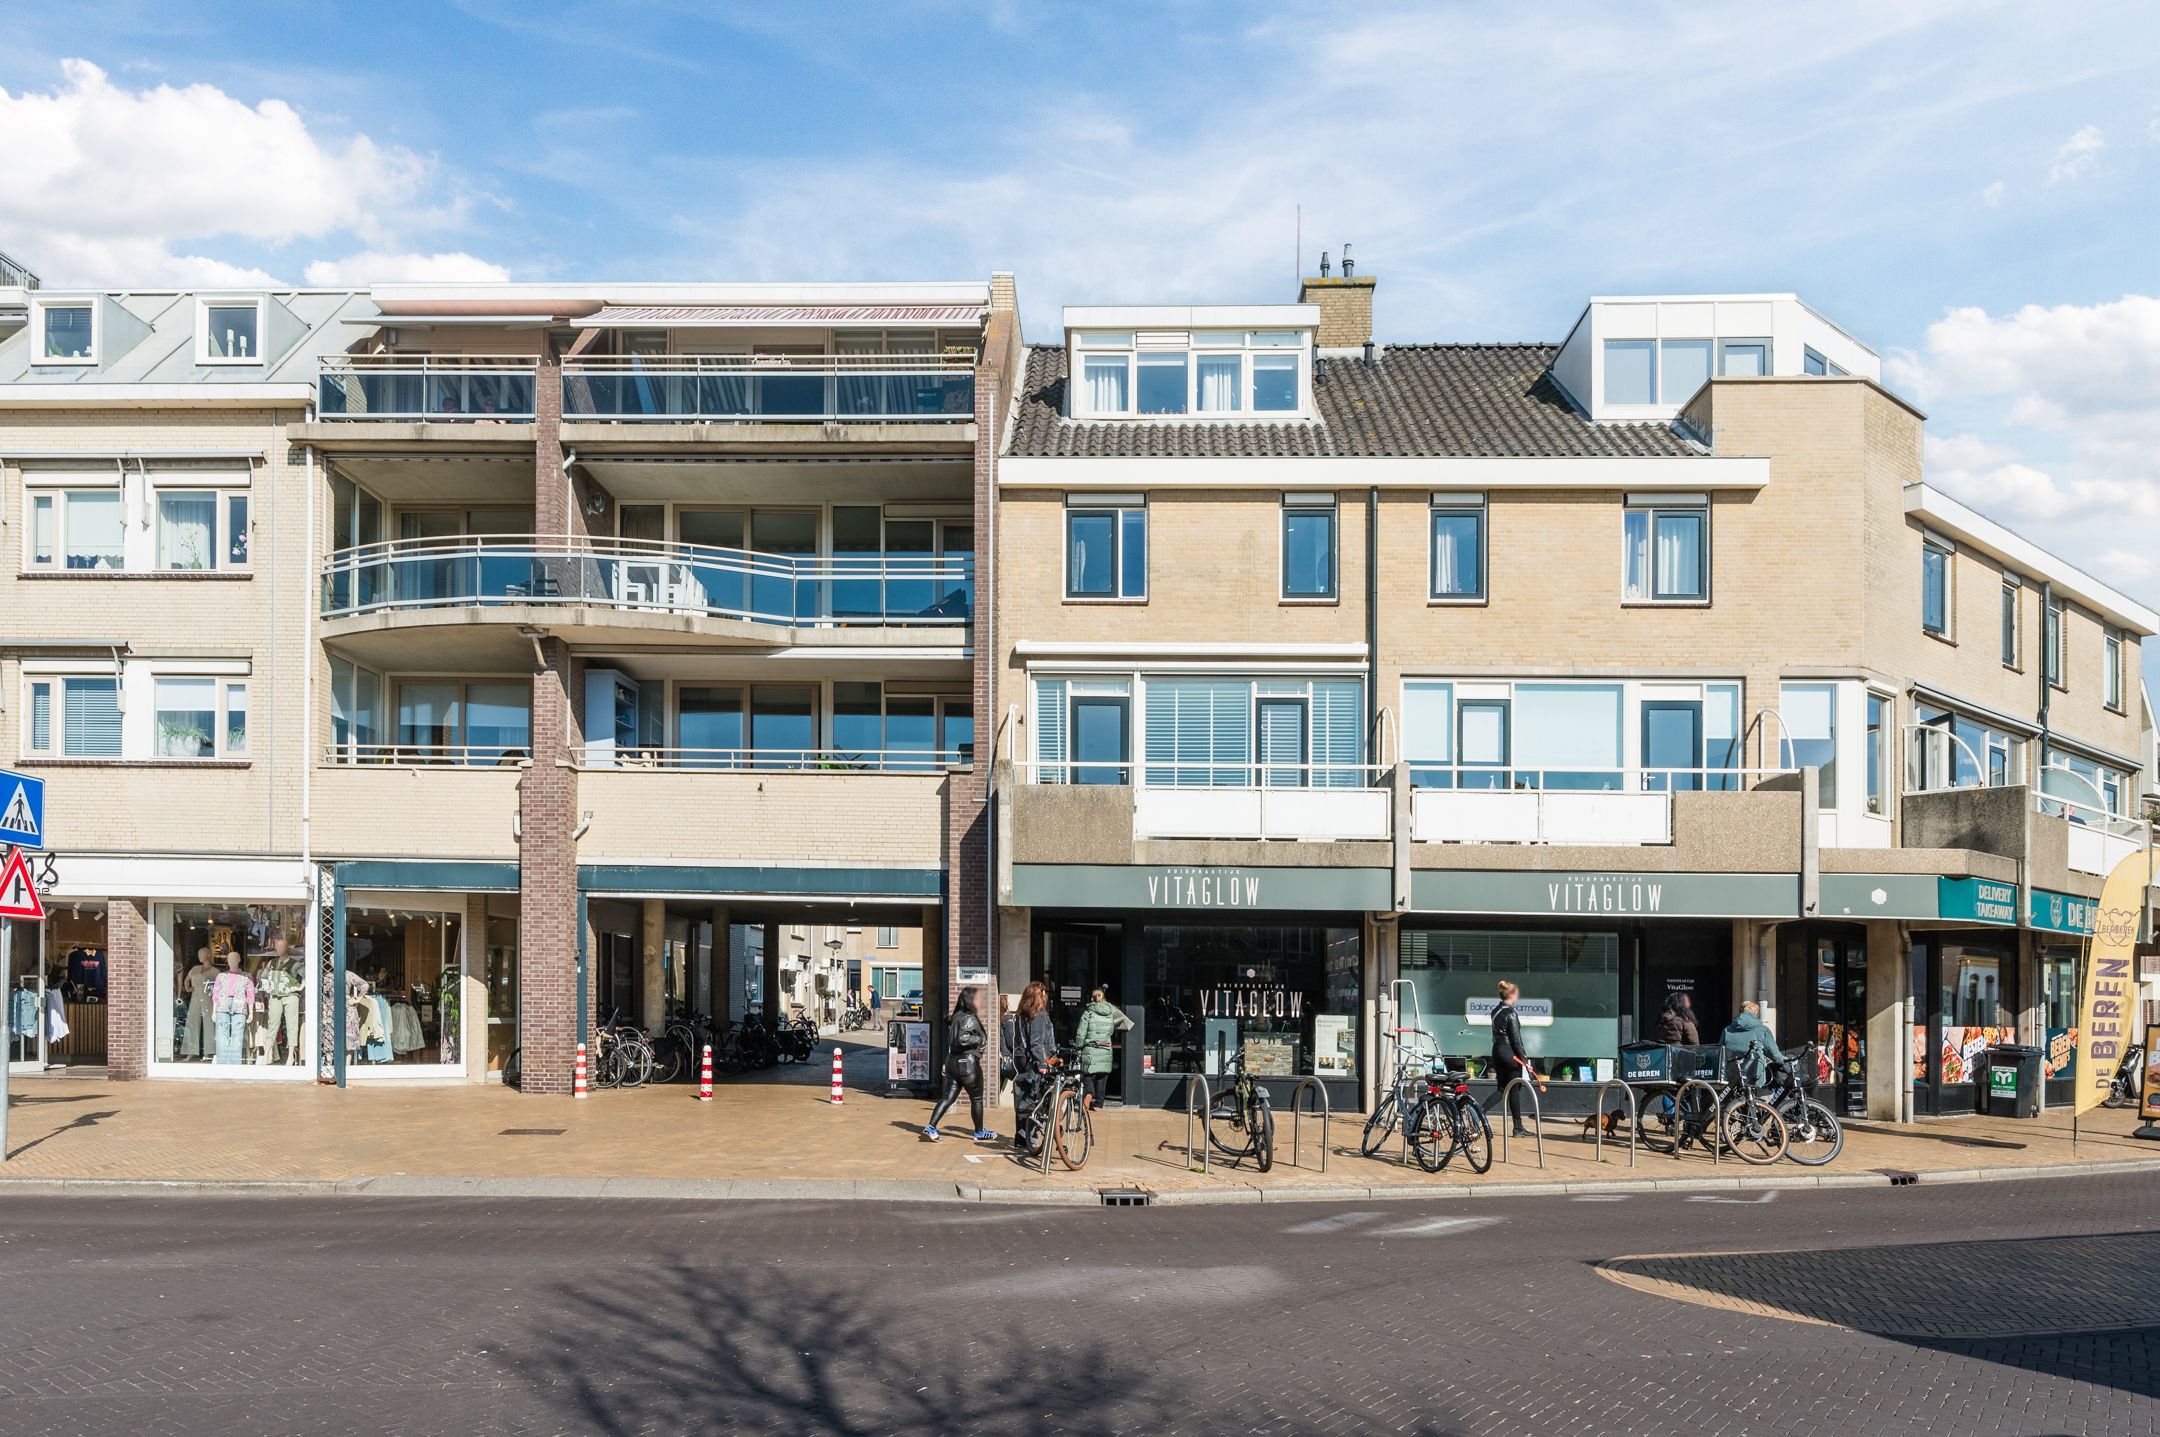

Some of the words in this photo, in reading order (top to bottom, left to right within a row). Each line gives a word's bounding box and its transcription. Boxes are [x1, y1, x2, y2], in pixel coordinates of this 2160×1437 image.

[1148, 876, 1259, 906] VITAGLOW
[1548, 883, 1662, 911] VITAGLOW
[1978, 884, 2012, 903] DELIVERY
[1976, 902, 2014, 920] TAKEAWAY
[2068, 902, 2083, 928] DE
[1200, 989, 1303, 1018] VITAGLOW
[1470, 1002, 1496, 1011] Balanc
[1515, 1003, 1549, 1014] armony
[2090, 958, 2130, 1059] BEREN
[1637, 1069, 1660, 1078] BEREN
[2095, 1068, 2112, 1089] DE
